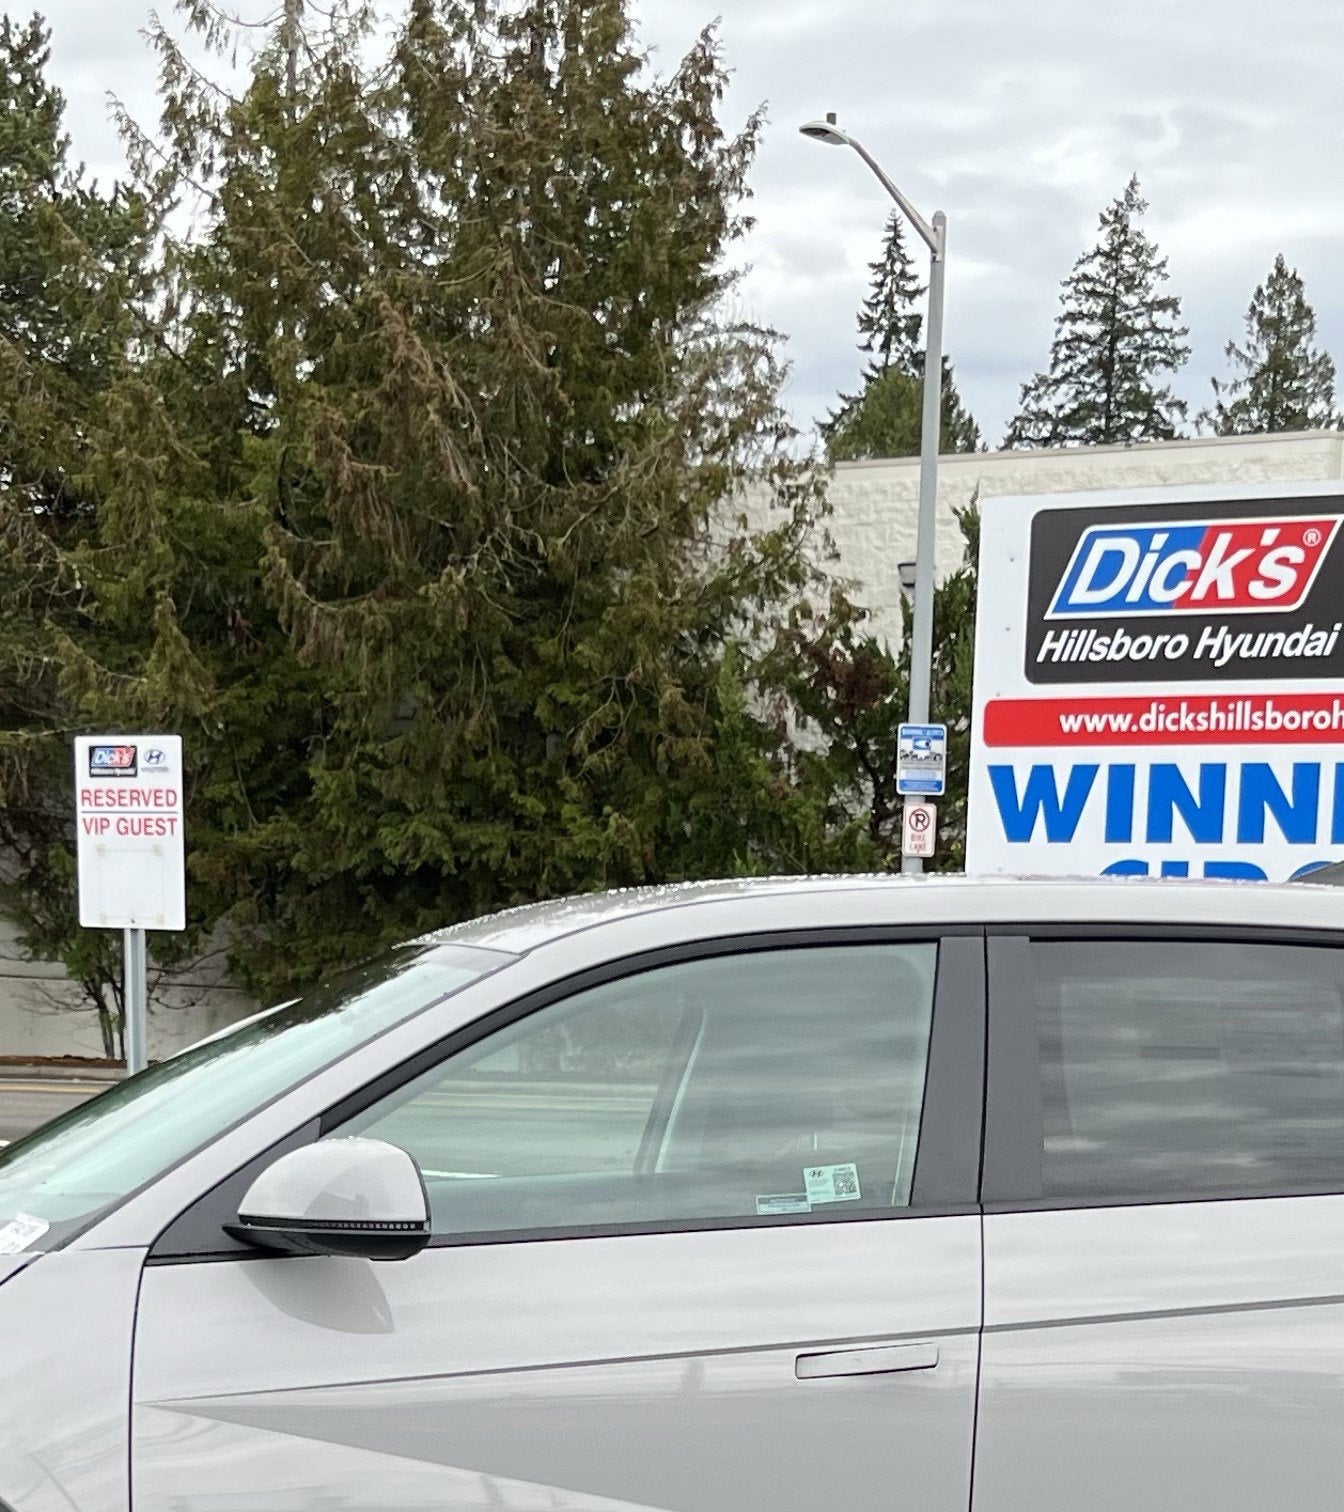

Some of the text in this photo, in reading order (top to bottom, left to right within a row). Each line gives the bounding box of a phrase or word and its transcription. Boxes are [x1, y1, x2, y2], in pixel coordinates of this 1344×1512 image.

[1036, 622, 1343, 667] Hillsboro Hyundai
[81, 789, 178, 807] RESERVED
[82, 817, 178, 836] VIP GUEST
